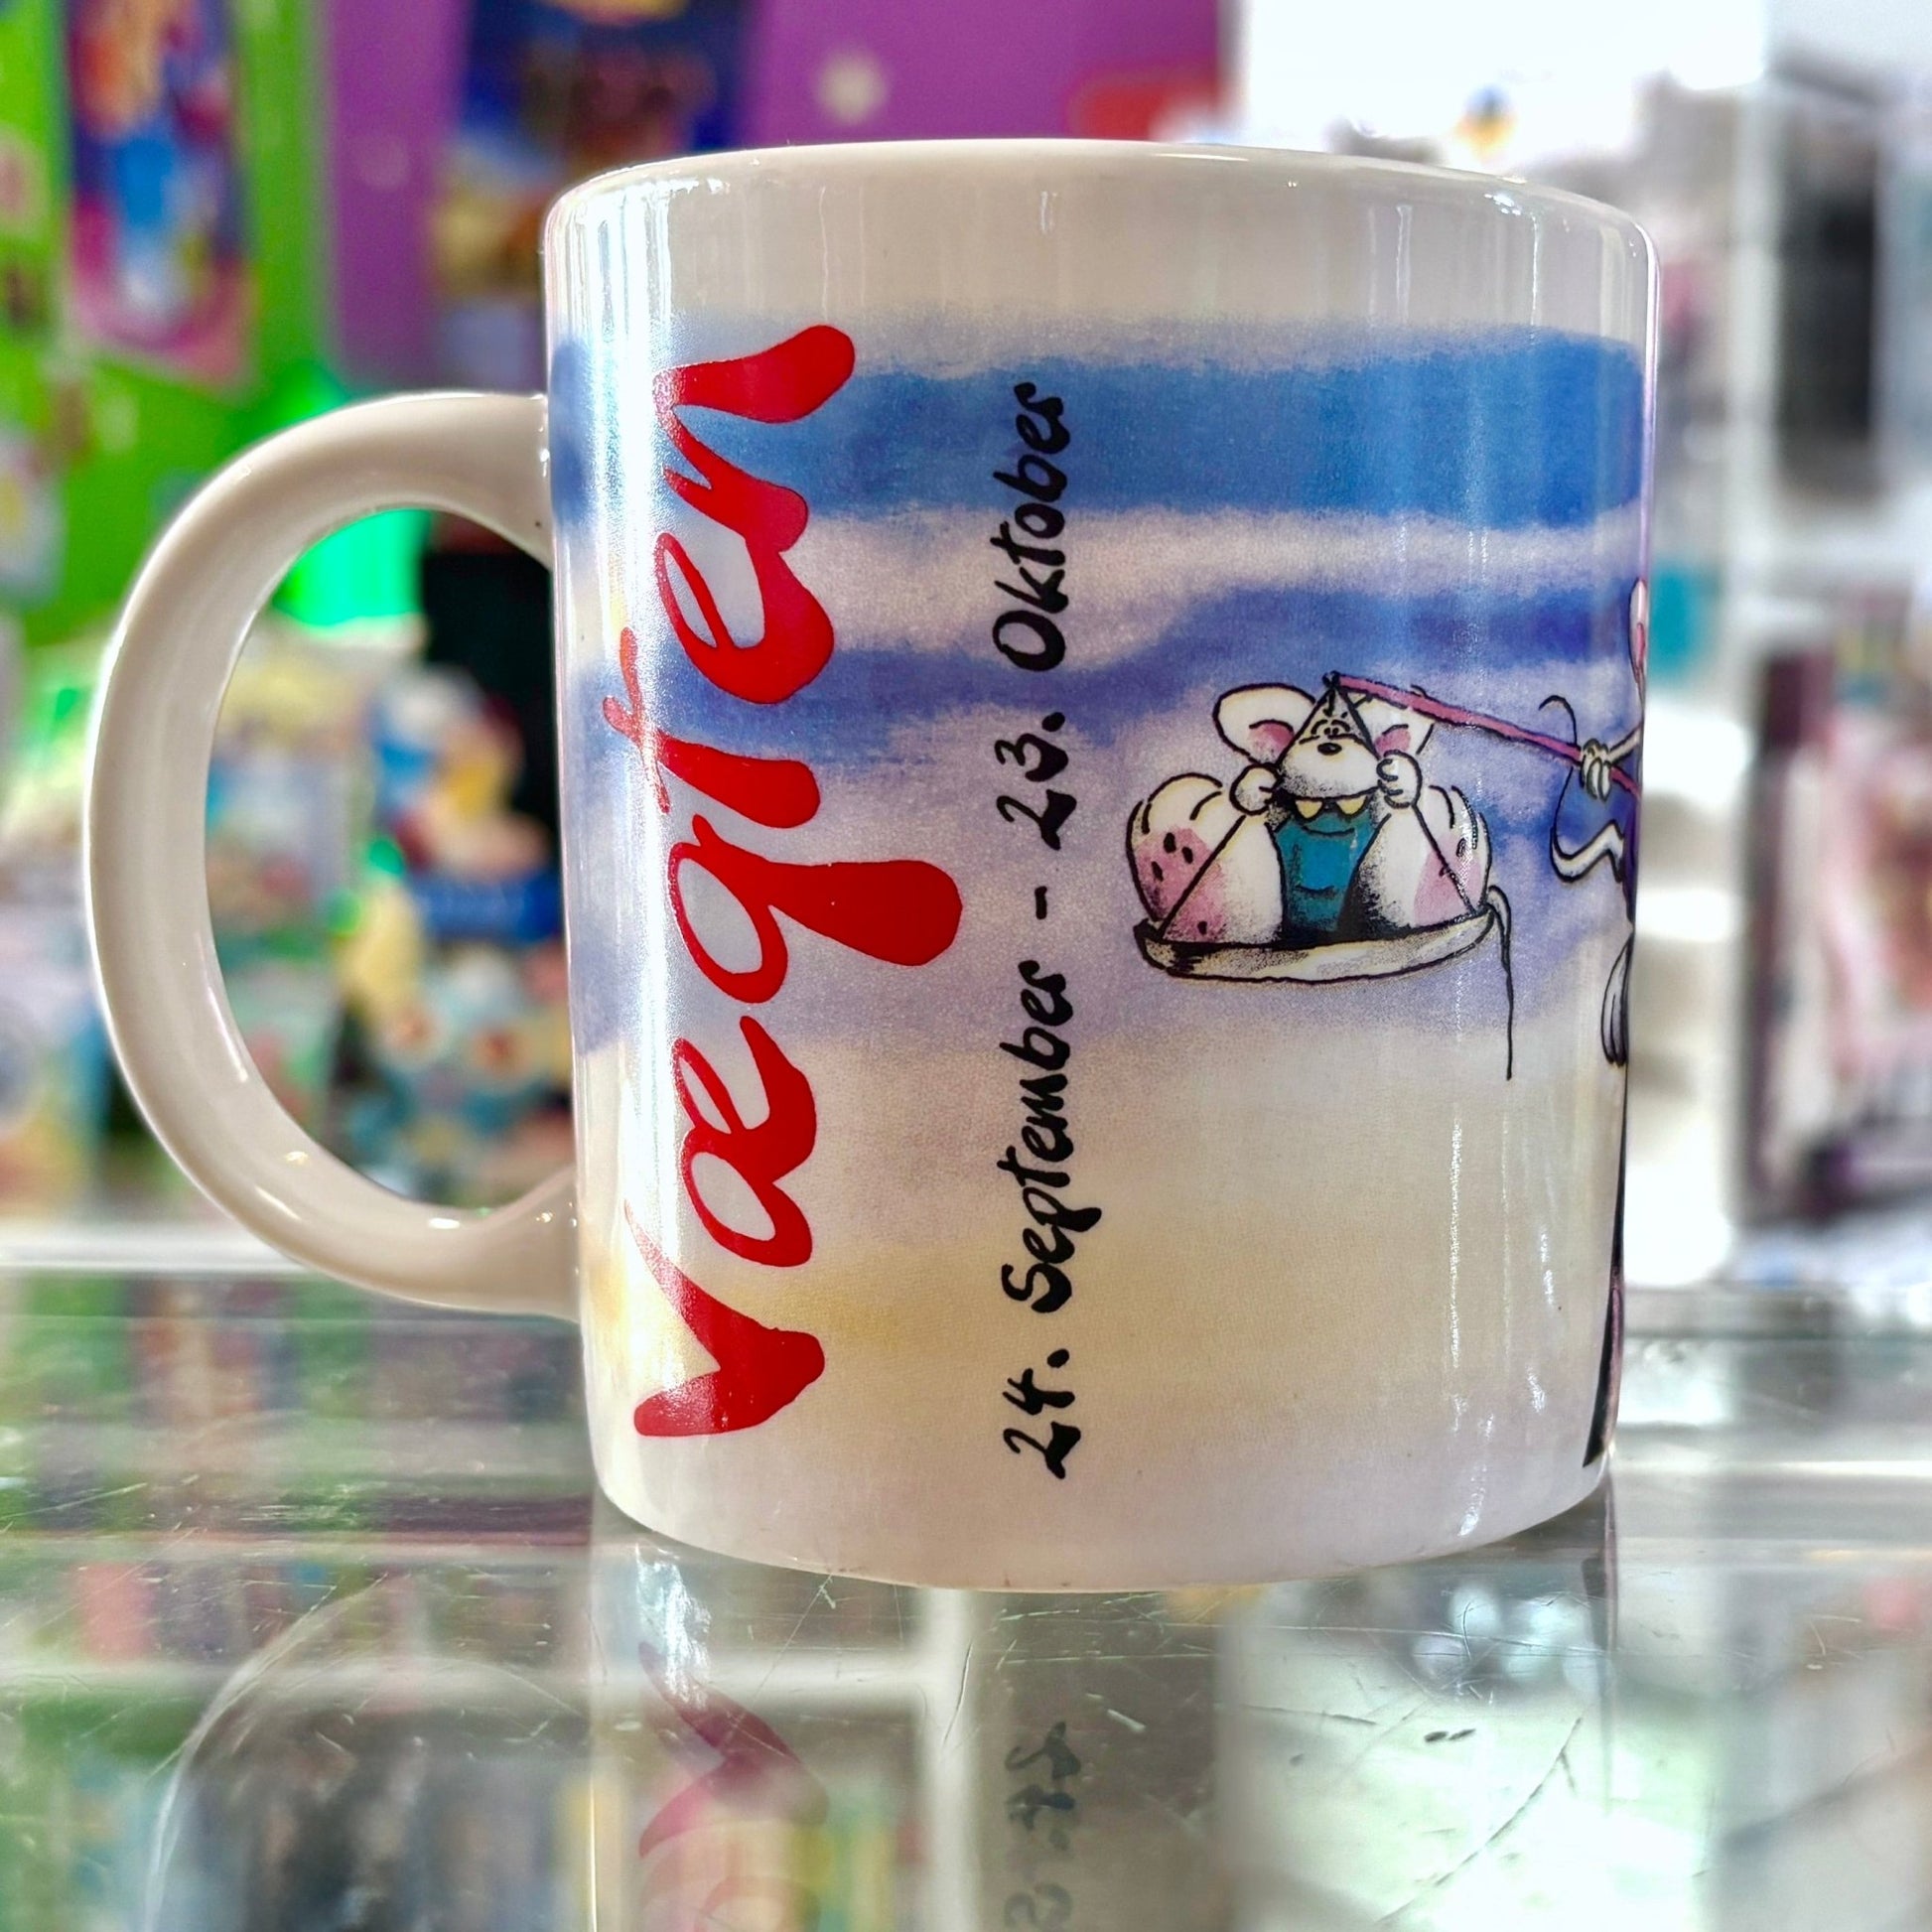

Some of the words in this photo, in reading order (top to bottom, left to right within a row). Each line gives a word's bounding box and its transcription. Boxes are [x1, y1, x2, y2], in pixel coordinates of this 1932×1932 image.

[990, 381, 1073, 675] Oktober
[994, 710, 1078, 853] 23.
[1034, 886, 1048, 920] -
[997, 959, 1103, 1314] September
[1002, 1348, 1083, 1480] 24.
